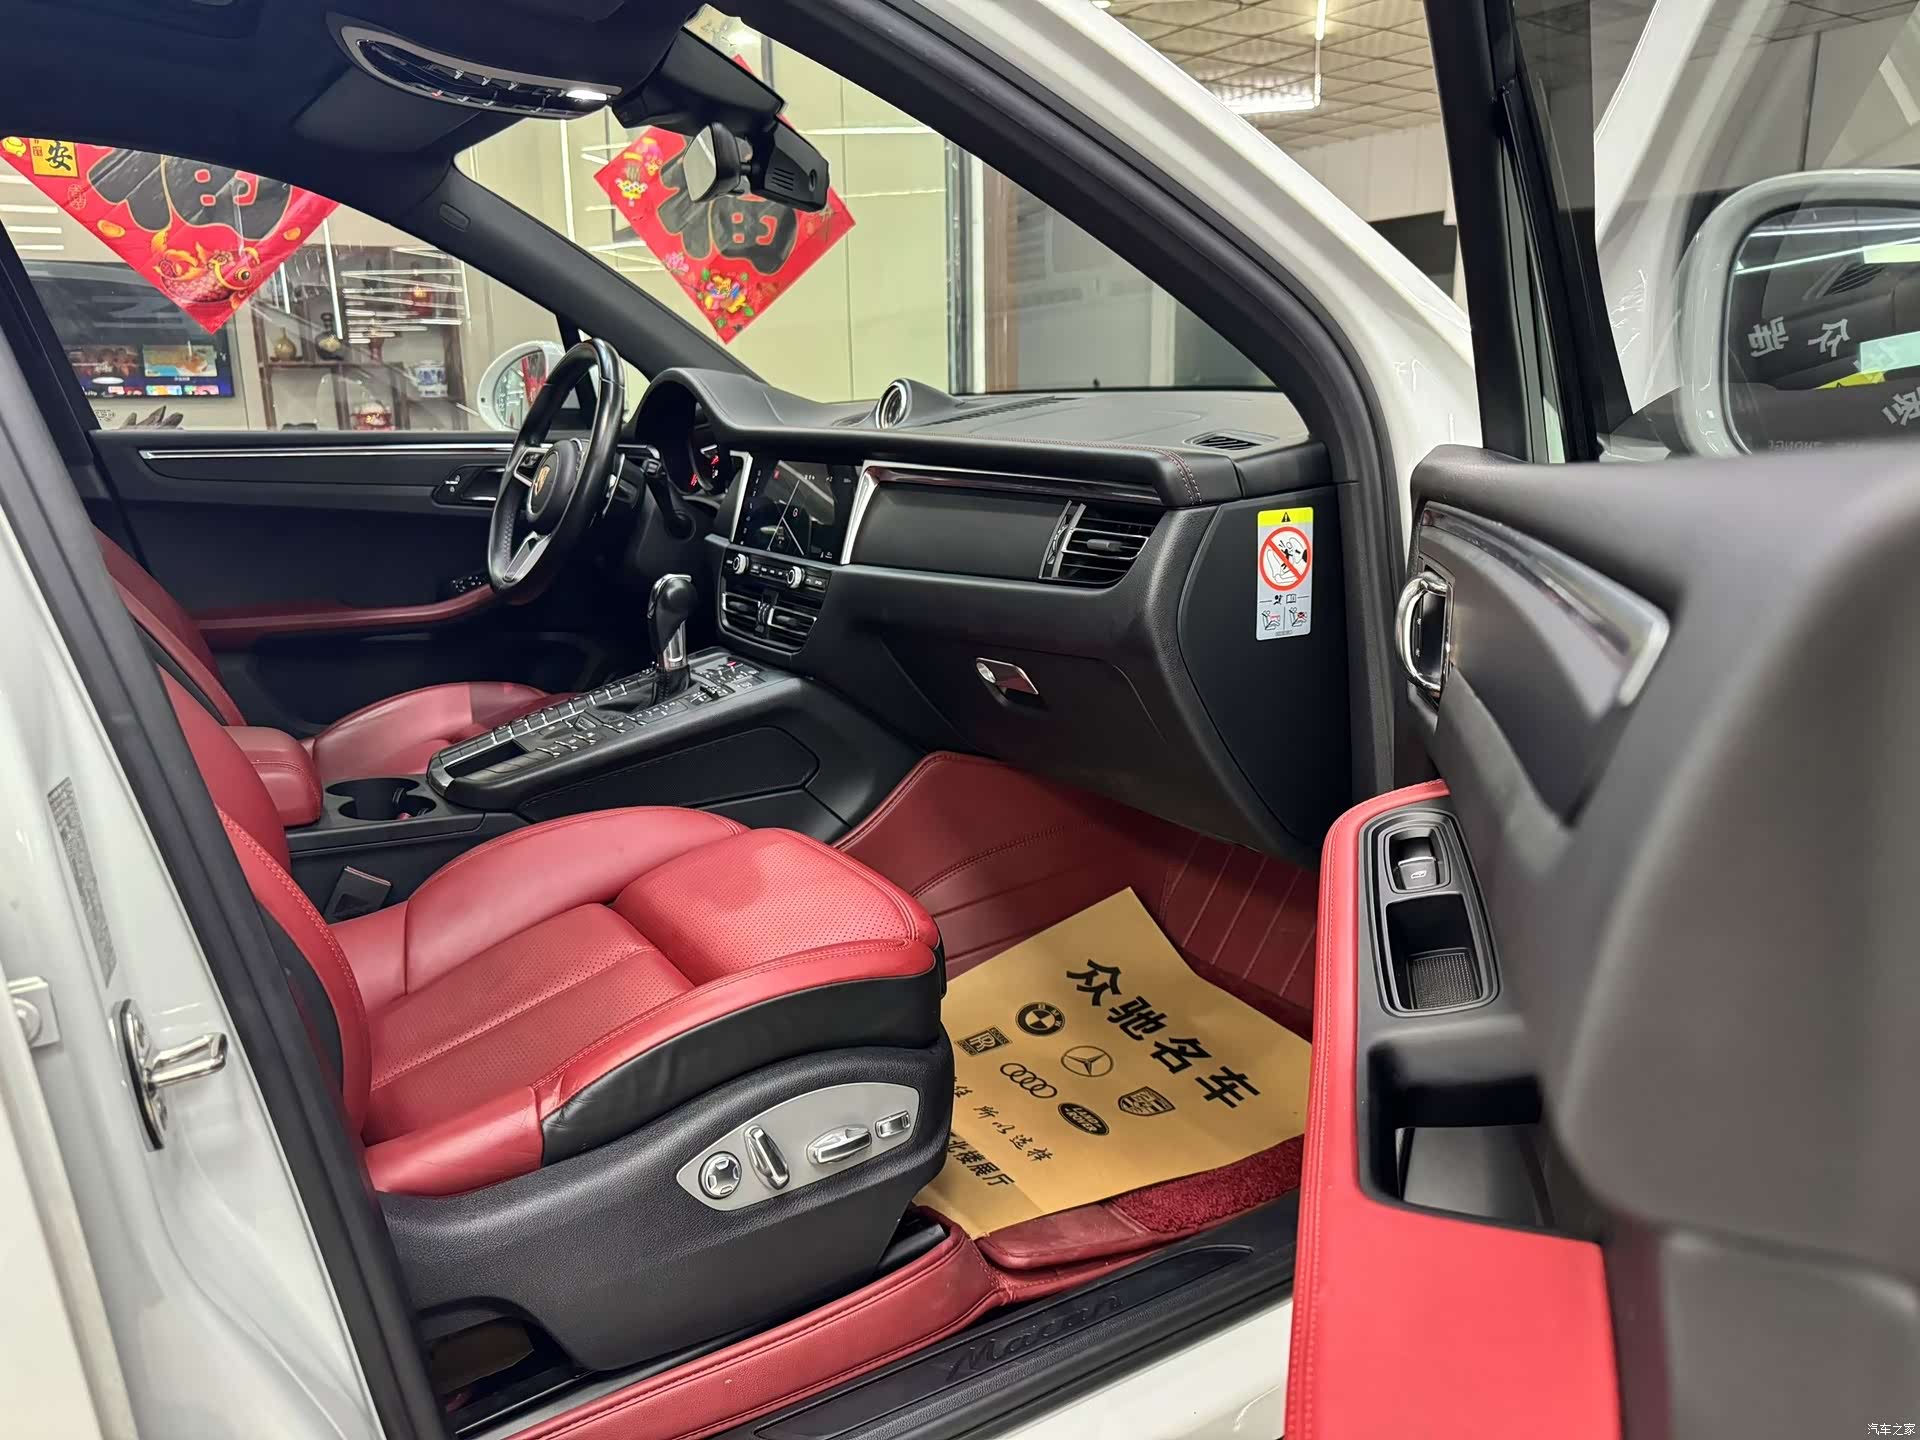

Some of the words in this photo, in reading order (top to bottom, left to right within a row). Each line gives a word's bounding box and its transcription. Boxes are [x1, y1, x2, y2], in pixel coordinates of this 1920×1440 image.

[45, 141, 73, 171] 安
[1065, 959, 1261, 1109] 众驰名车
[948, 1131, 1015, 1186] 北楼展厅
